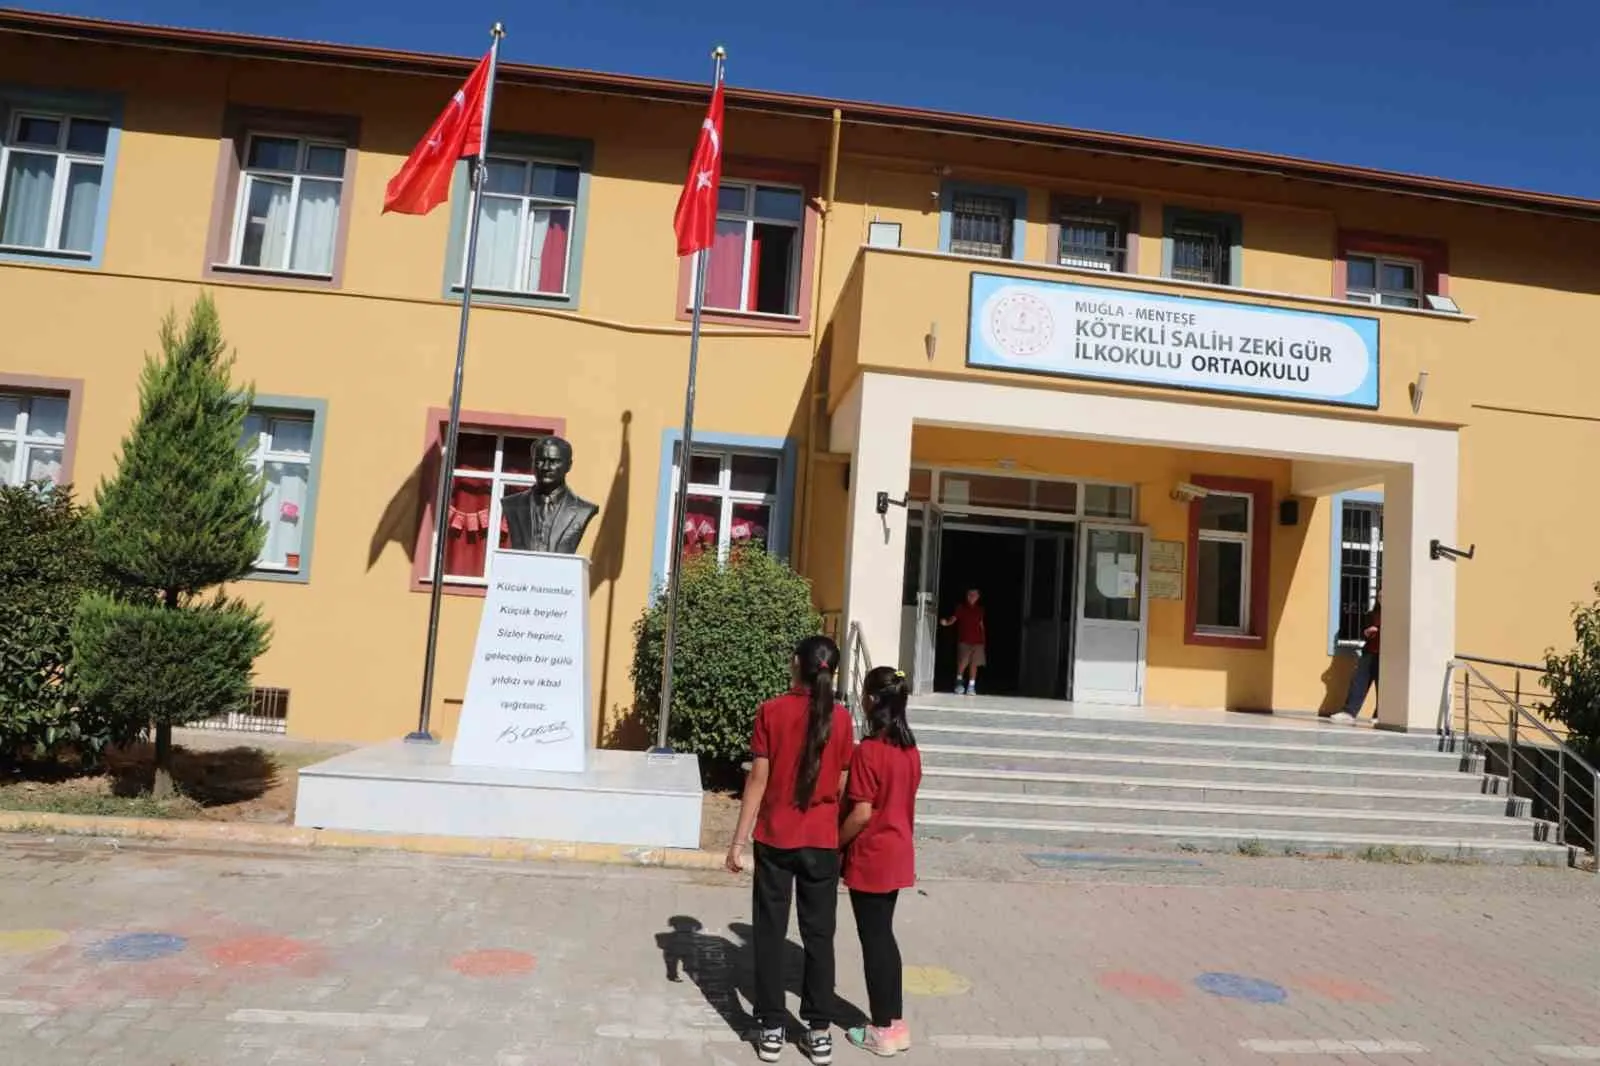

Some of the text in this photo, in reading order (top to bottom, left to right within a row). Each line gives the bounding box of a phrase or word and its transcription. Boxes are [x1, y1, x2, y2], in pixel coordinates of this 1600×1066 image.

[1075, 300, 1125, 317] MUĞLA
[1136, 308, 1196, 326] MENTEŞE
[1076, 317, 1332, 364] KÖTEKLİ SALİH ZEKİ GÜR
[1074, 338, 1310, 382] İLKOKULU ORTAOKULU
[534, 655, 549, 663] bir
